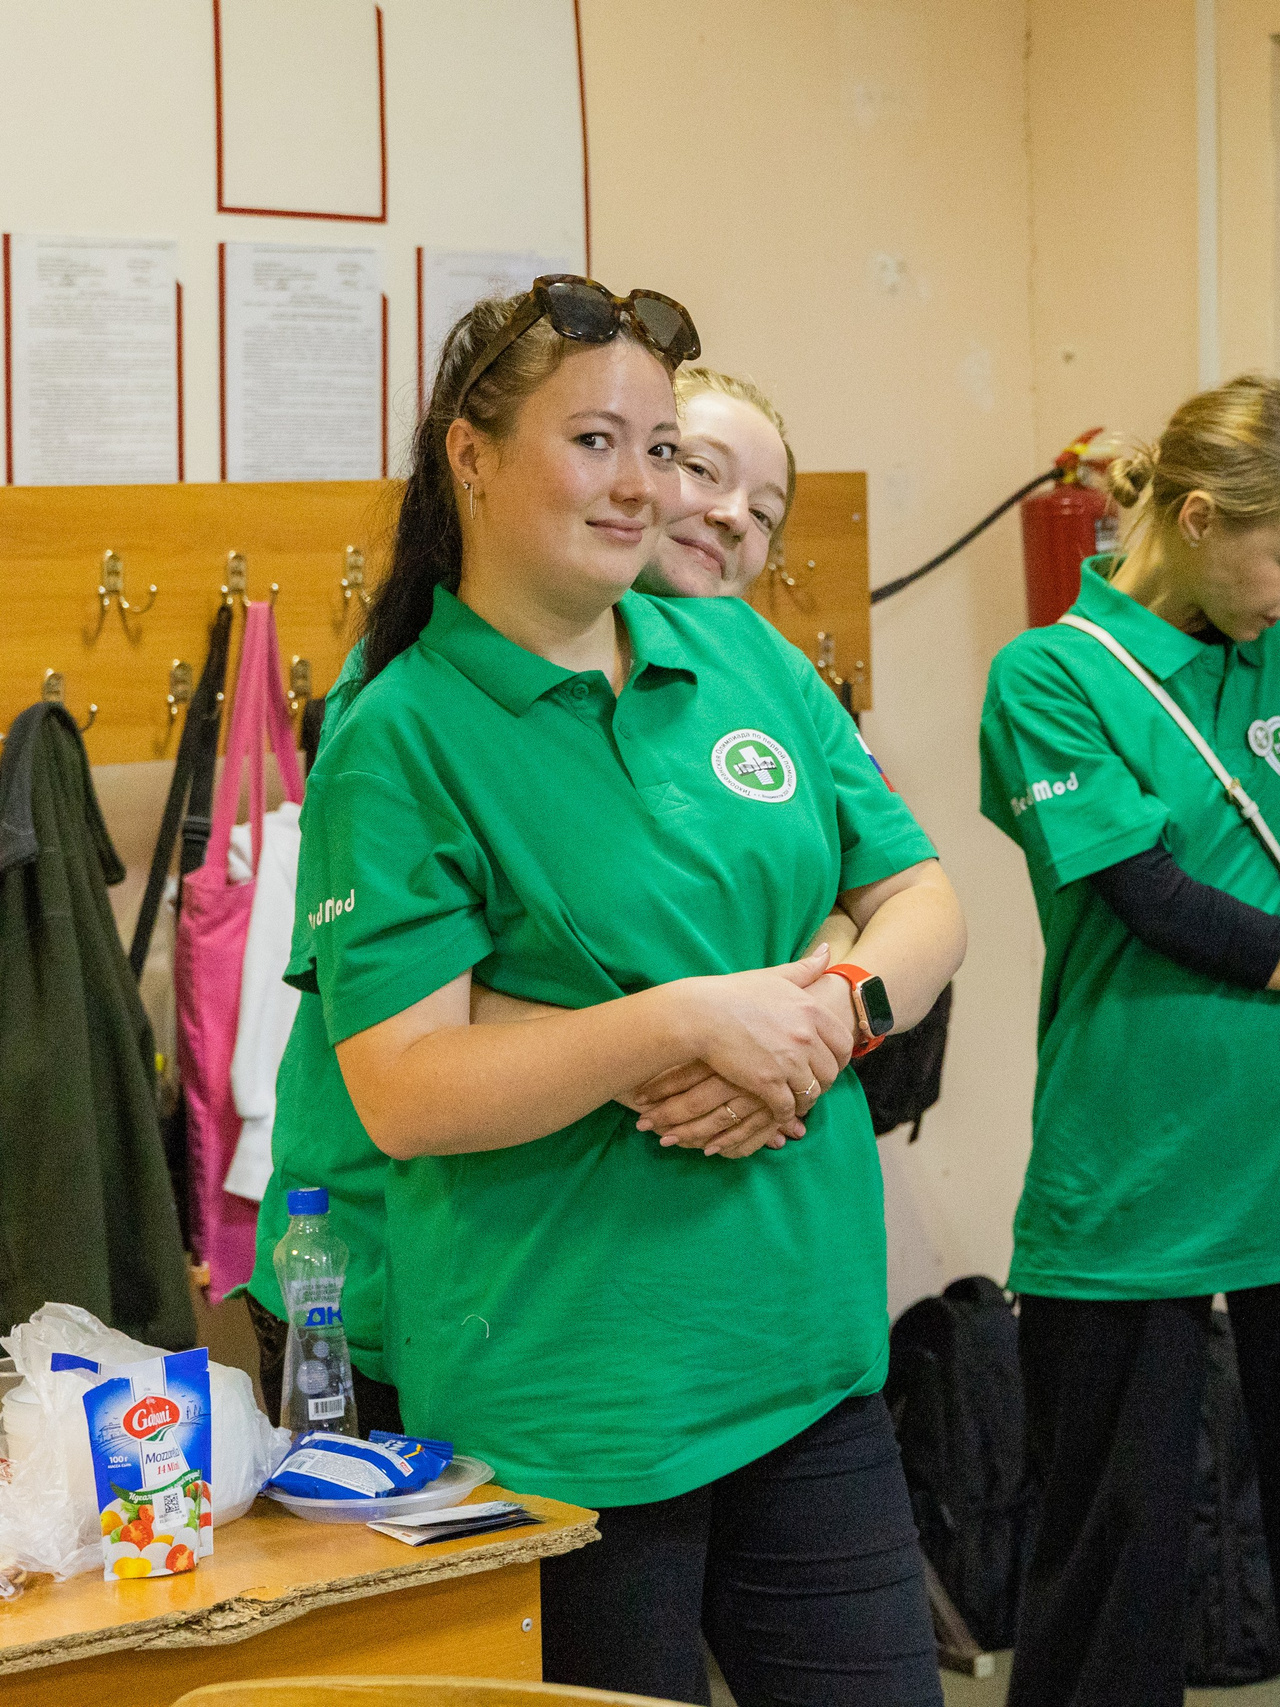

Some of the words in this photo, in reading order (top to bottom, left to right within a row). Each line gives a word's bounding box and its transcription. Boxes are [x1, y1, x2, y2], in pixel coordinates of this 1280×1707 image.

[716, 732, 751, 755] Олимпиада
[762, 737, 786, 760] первой
[109, 1455, 124, 1464] 100
[157, 1464, 166, 1475] 14
